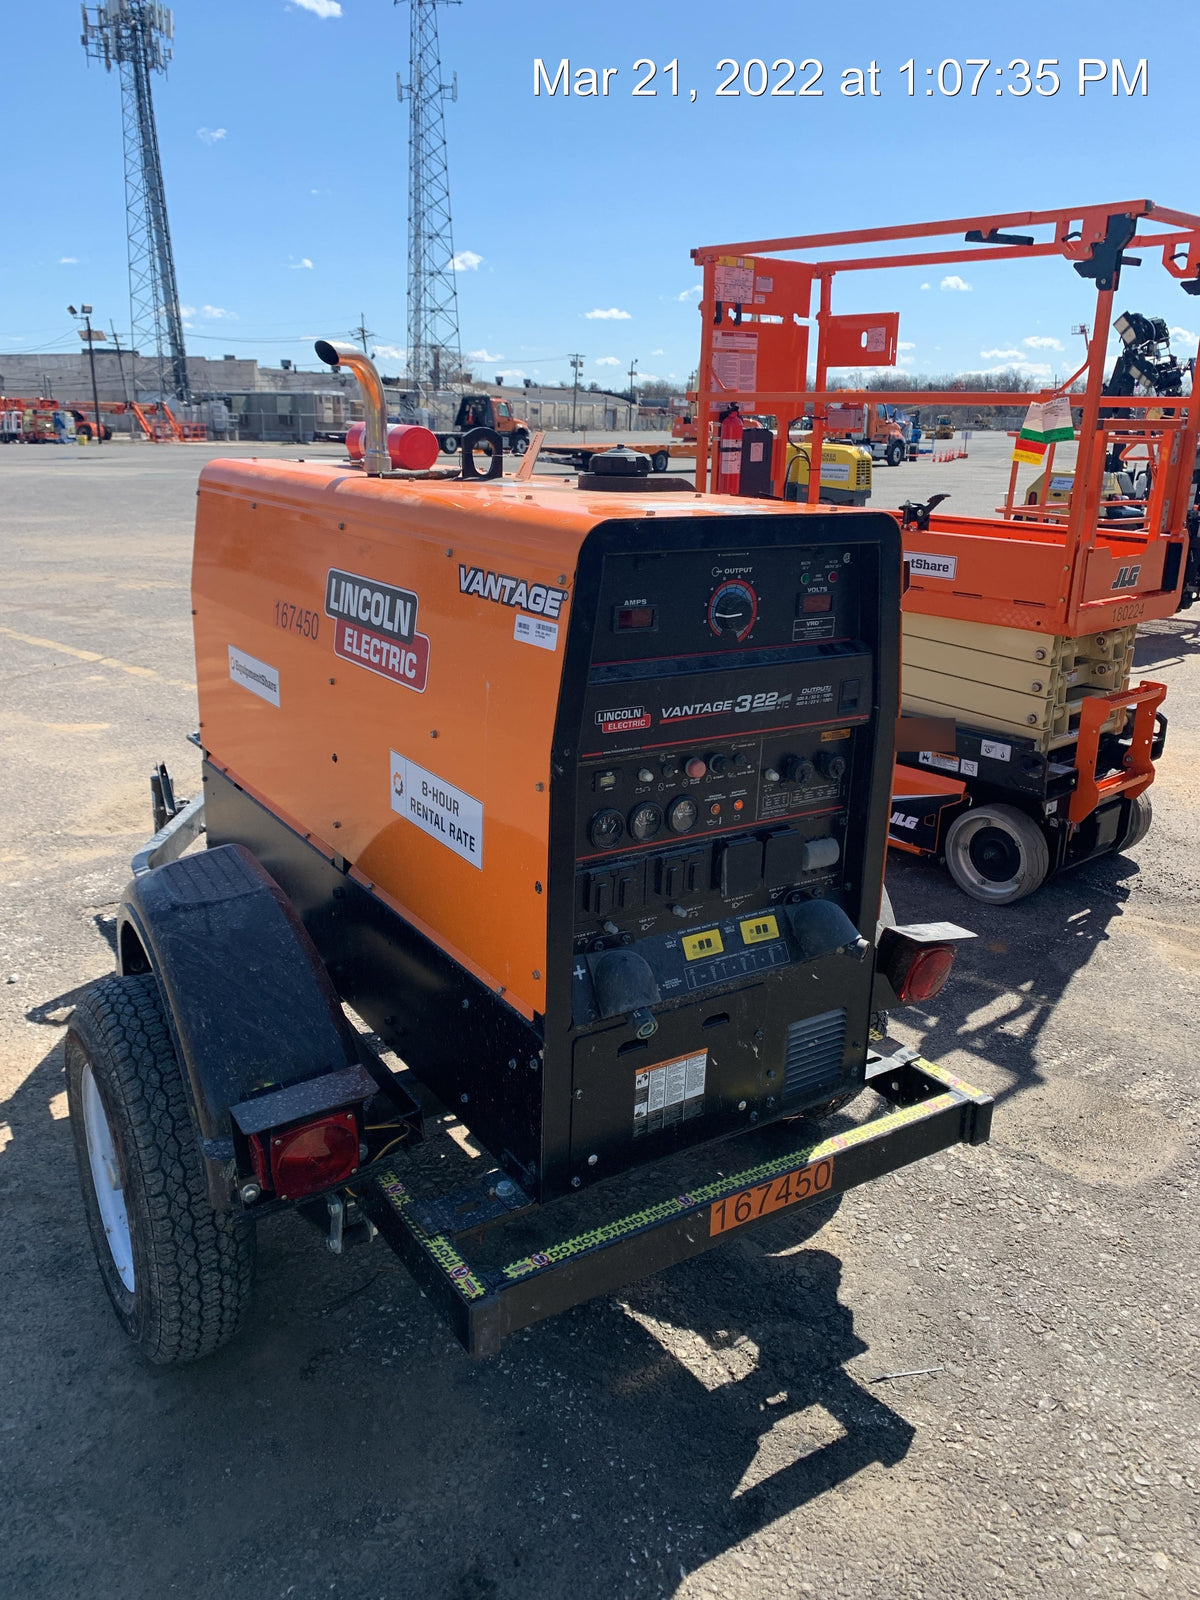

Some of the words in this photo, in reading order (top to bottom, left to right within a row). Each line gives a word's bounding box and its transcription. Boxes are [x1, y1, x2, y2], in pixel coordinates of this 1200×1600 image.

[723, 566, 753, 575] OUTPUT
[1110, 564, 1142, 590] JLG
[330, 578, 412, 637] LINCOLN
[459, 564, 563, 620] VANTAGE
[623, 598, 648, 606] AMPS
[275, 601, 320, 641] 167450
[1112, 603, 1145, 623] 180224
[343, 627, 418, 679] ELECTRIC
[597, 708, 642, 722] LINCOLN
[660, 700, 734, 719] VANTAGE
[734, 691, 780, 713] 322
[607, 718, 647, 731] ELECTRIC
[421, 780, 460, 818] 8-HOUR
[410, 796, 446, 833] RENTAL
[449, 821, 475, 853] RATE
[889, 811, 919, 830] JLG
[715, 1160, 832, 1231] 167450
[550, 1243, 571, 1260] DO
[571, 1233, 602, 1251] NOT
[602, 1215, 643, 1237] STAND
[645, 1202, 680, 1222] HERE
